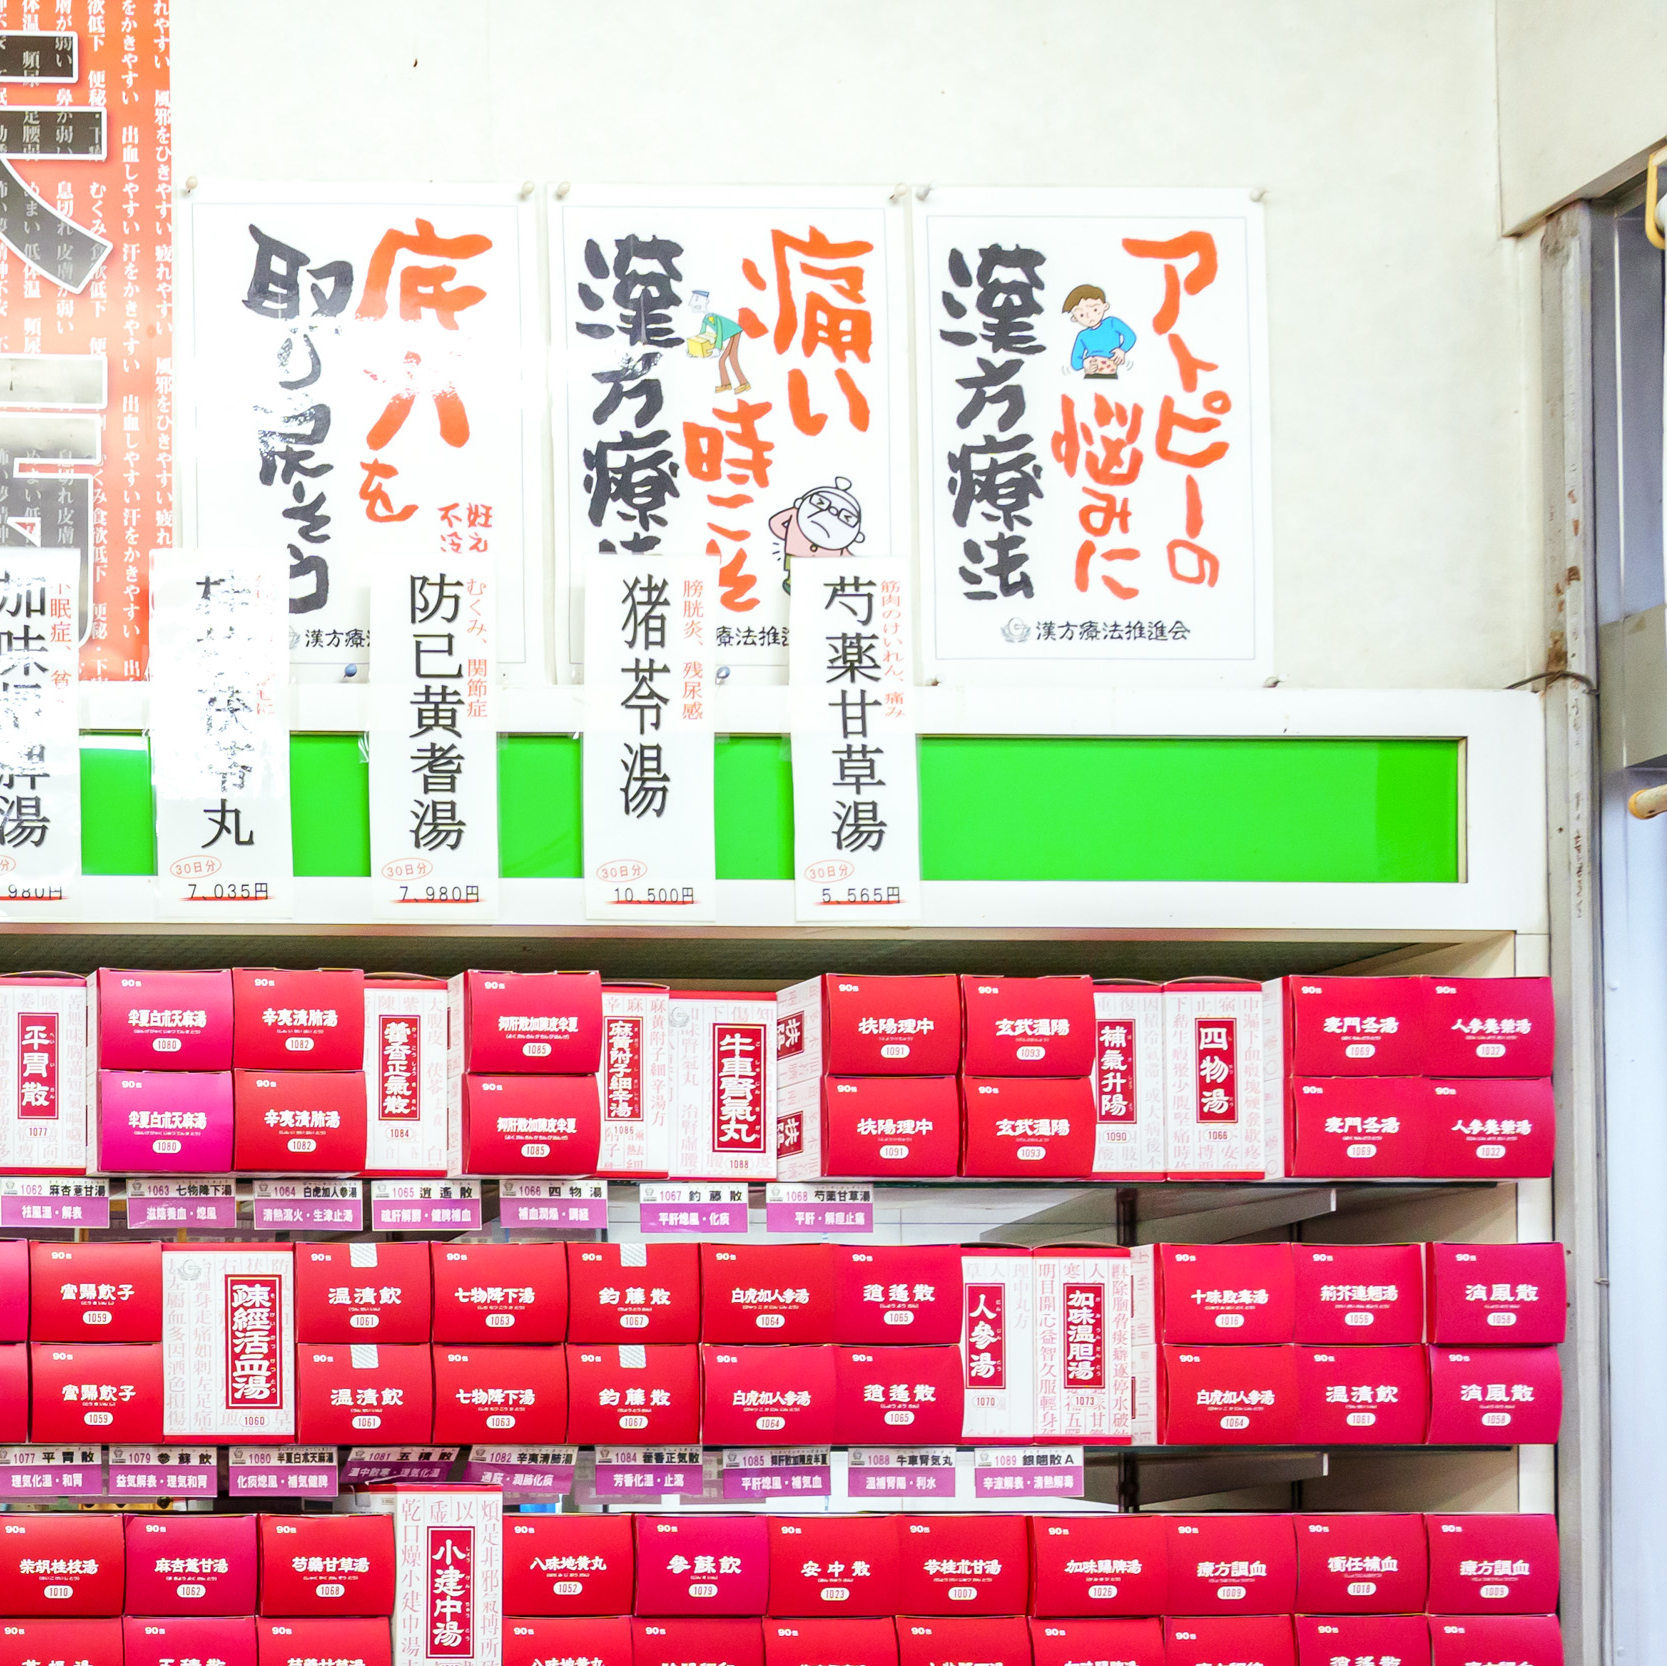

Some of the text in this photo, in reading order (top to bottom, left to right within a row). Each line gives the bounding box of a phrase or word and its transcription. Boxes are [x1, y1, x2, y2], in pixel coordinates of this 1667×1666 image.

[154, 89, 173, 235] 風邪をひきやすい
[122, 242, 141, 375] 汗をかきやすい
[738, 225, 874, 436] 痛い
[940, 243, 1047, 602] 漢方療法
[1122, 230, 1233, 589] アトピーの
[1051, 392, 1145, 601] 悩みに
[304, 627, 371, 649] 漢方療
[1036, 619, 1191, 643] 漢方療法推進会
[620, 574, 671, 820] 猪苓湯
[823, 575, 888, 854] 芍薬甘草湯
[21, 1026, 49, 1107] 平胃散
[857, 1018, 935, 1035] 扶陽理中
[1199, 1028, 1230, 1114] 四物湯
[274, 1186, 296, 1198] 1064
[432, 1538, 465, 1648] 小建中湯
[530, 1556, 606, 1572] 八味地黄丸
[558, 1583, 578, 1594] 1052
